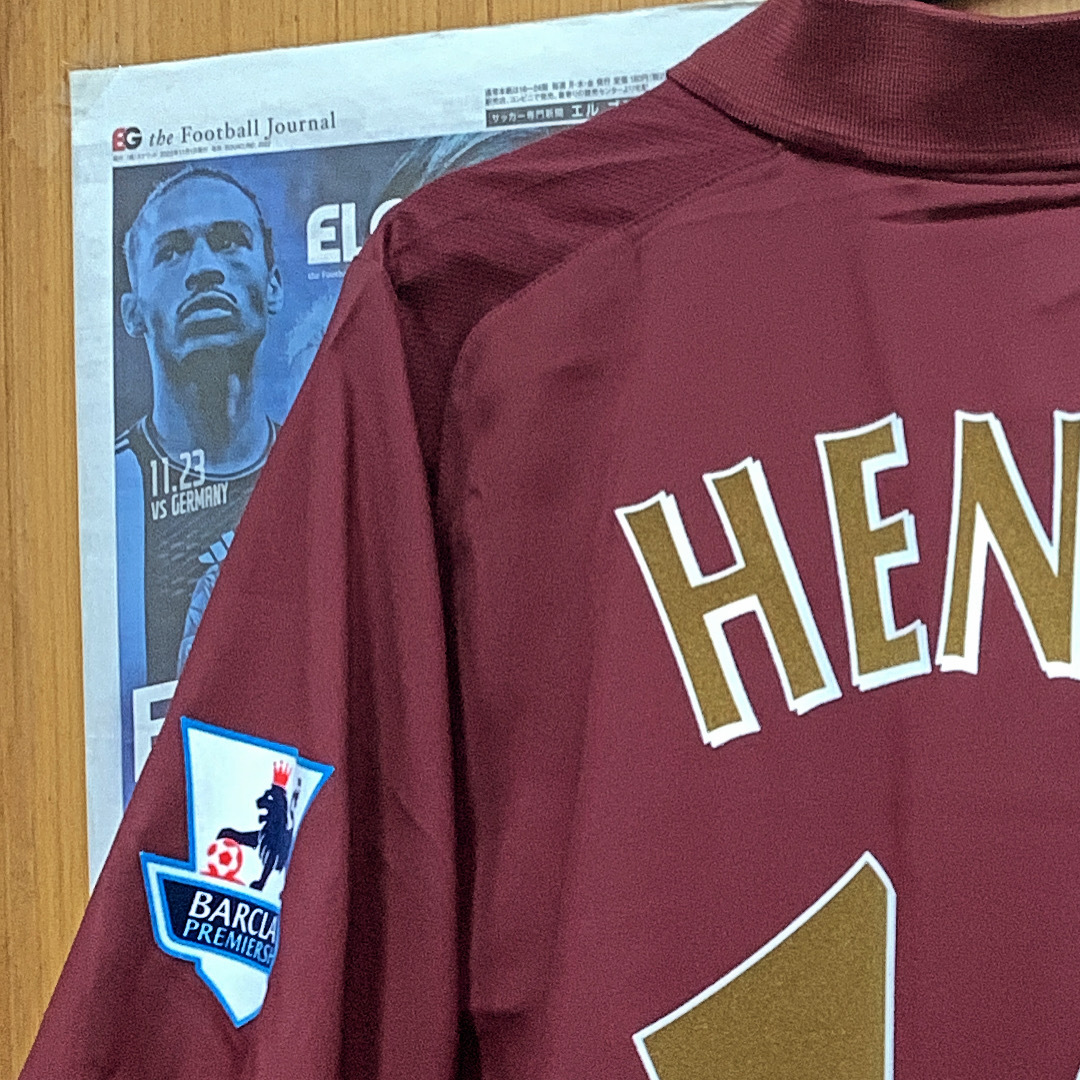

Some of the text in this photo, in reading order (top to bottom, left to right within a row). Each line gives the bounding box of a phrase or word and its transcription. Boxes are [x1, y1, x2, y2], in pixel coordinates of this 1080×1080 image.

[149, 129, 174, 147] the
[181, 118, 259, 144] Football
[264, 110, 336, 141] Journal
[150, 449, 206, 497] 11.23
[151, 481, 229, 520] VS GERMANY
